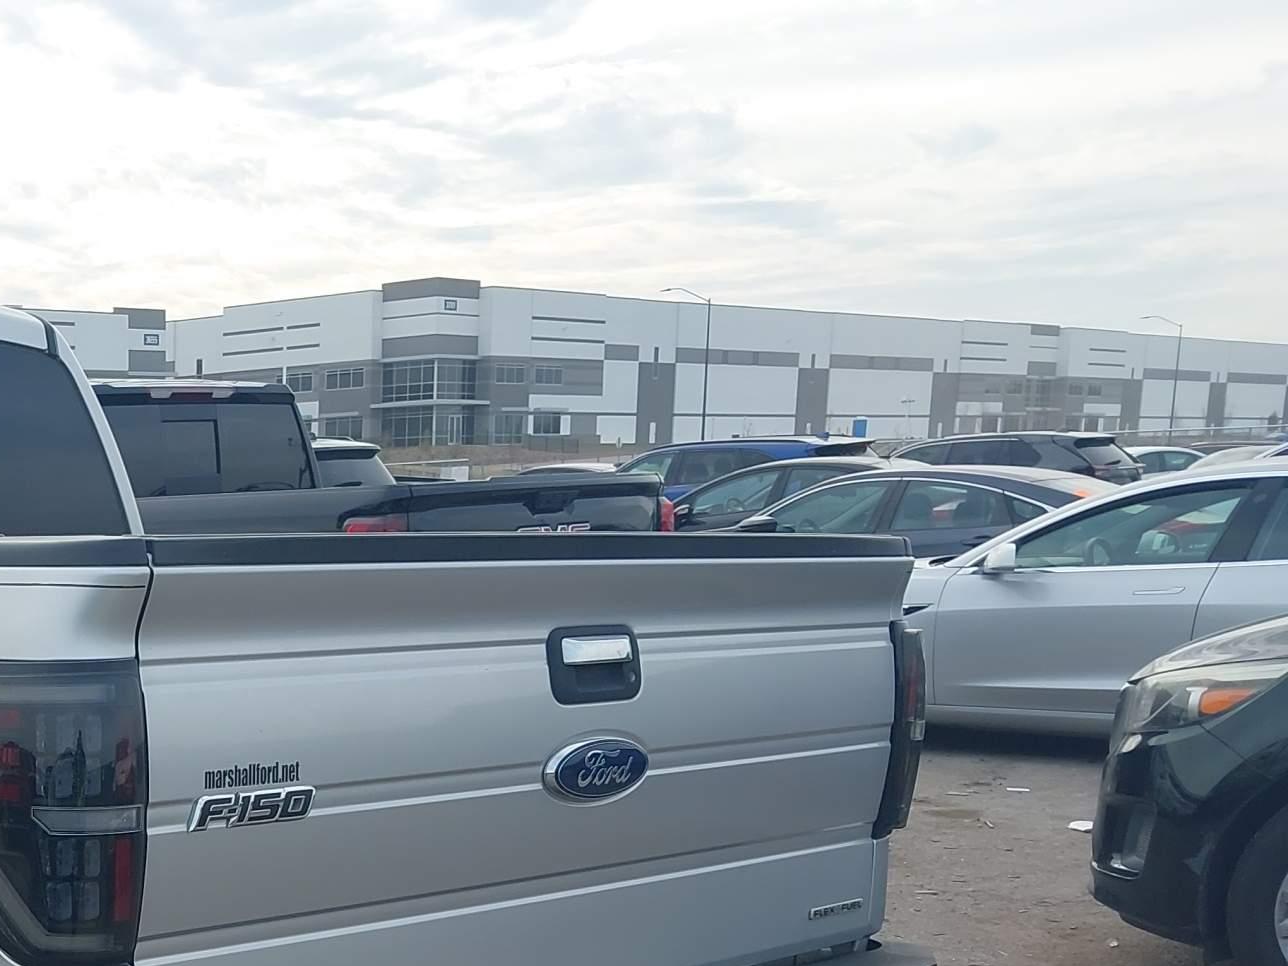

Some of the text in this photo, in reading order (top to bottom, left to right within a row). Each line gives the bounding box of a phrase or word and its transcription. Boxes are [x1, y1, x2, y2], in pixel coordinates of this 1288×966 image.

[204, 761, 300, 790] marshallford.net
[577, 749, 634, 788] Ford
[189, 786, 316, 832] F-150
